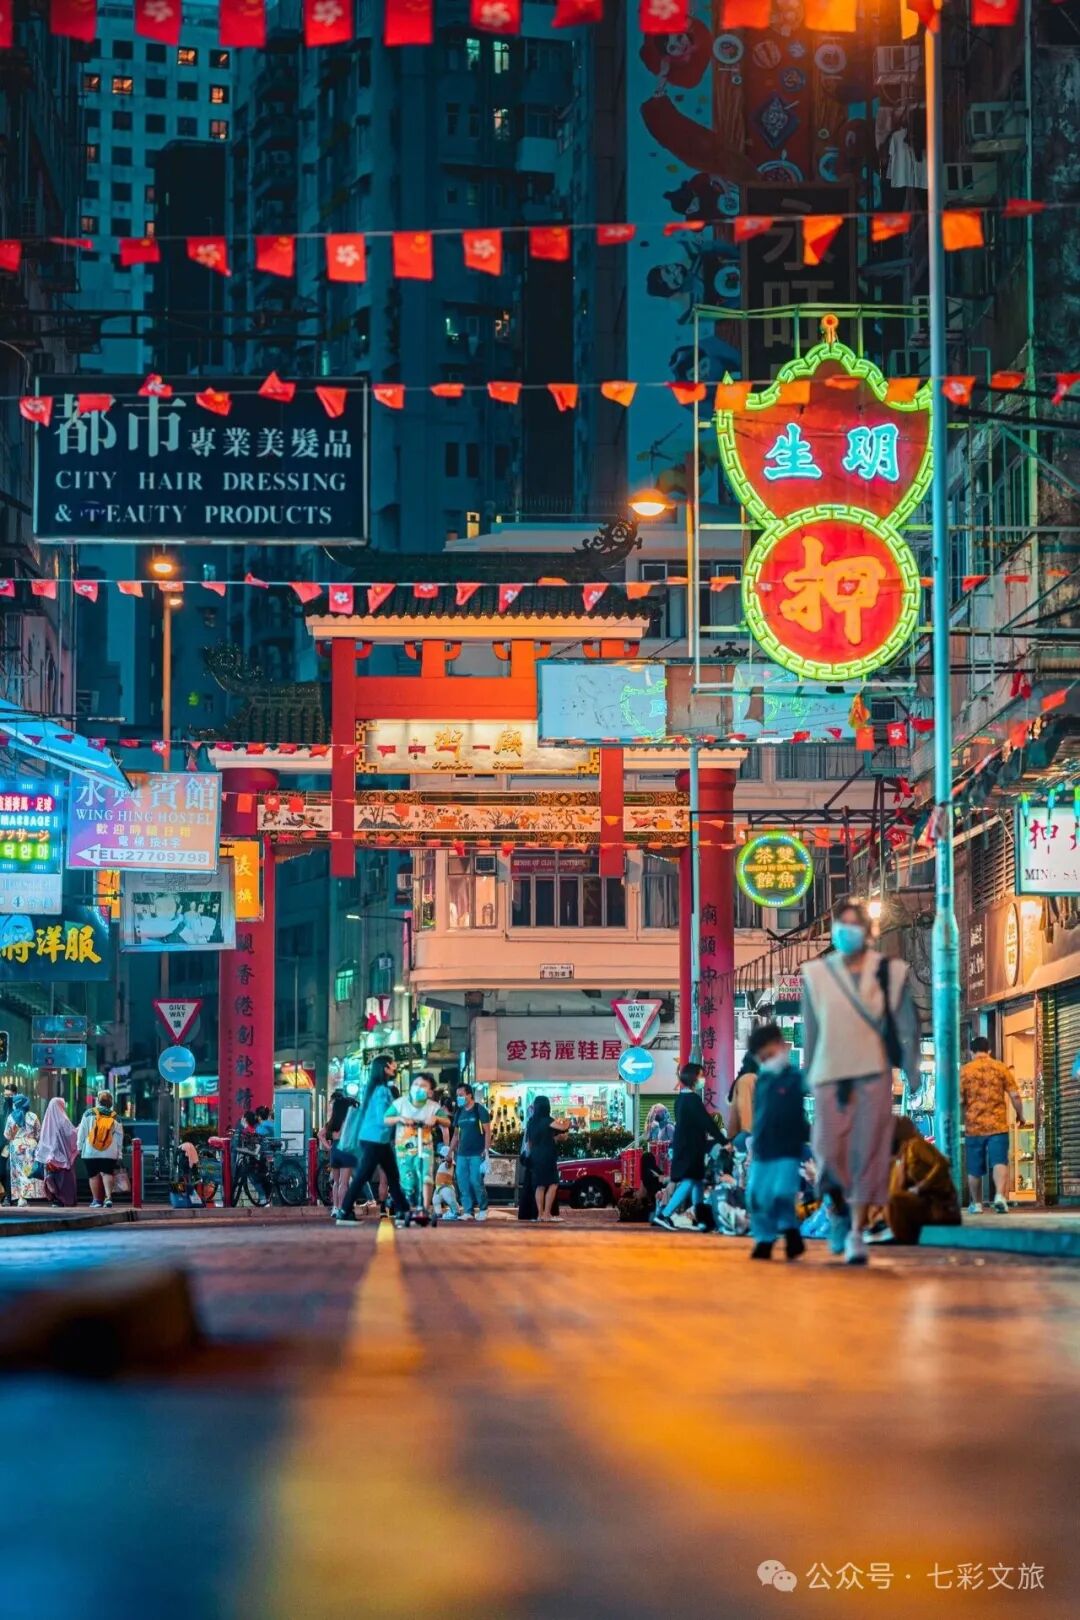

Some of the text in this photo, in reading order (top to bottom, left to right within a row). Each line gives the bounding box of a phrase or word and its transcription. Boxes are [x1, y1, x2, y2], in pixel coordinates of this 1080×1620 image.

[55, 471, 347, 491] CITY HAIR DRESSING
[55, 503, 332, 524] & EAUTY PRODUCTS
[781, 536, 886, 645] 押
[76, 809, 213, 825] WING HING HOSTEL
[506, 1039, 622, 1061] 愛琦麗鞋屋
